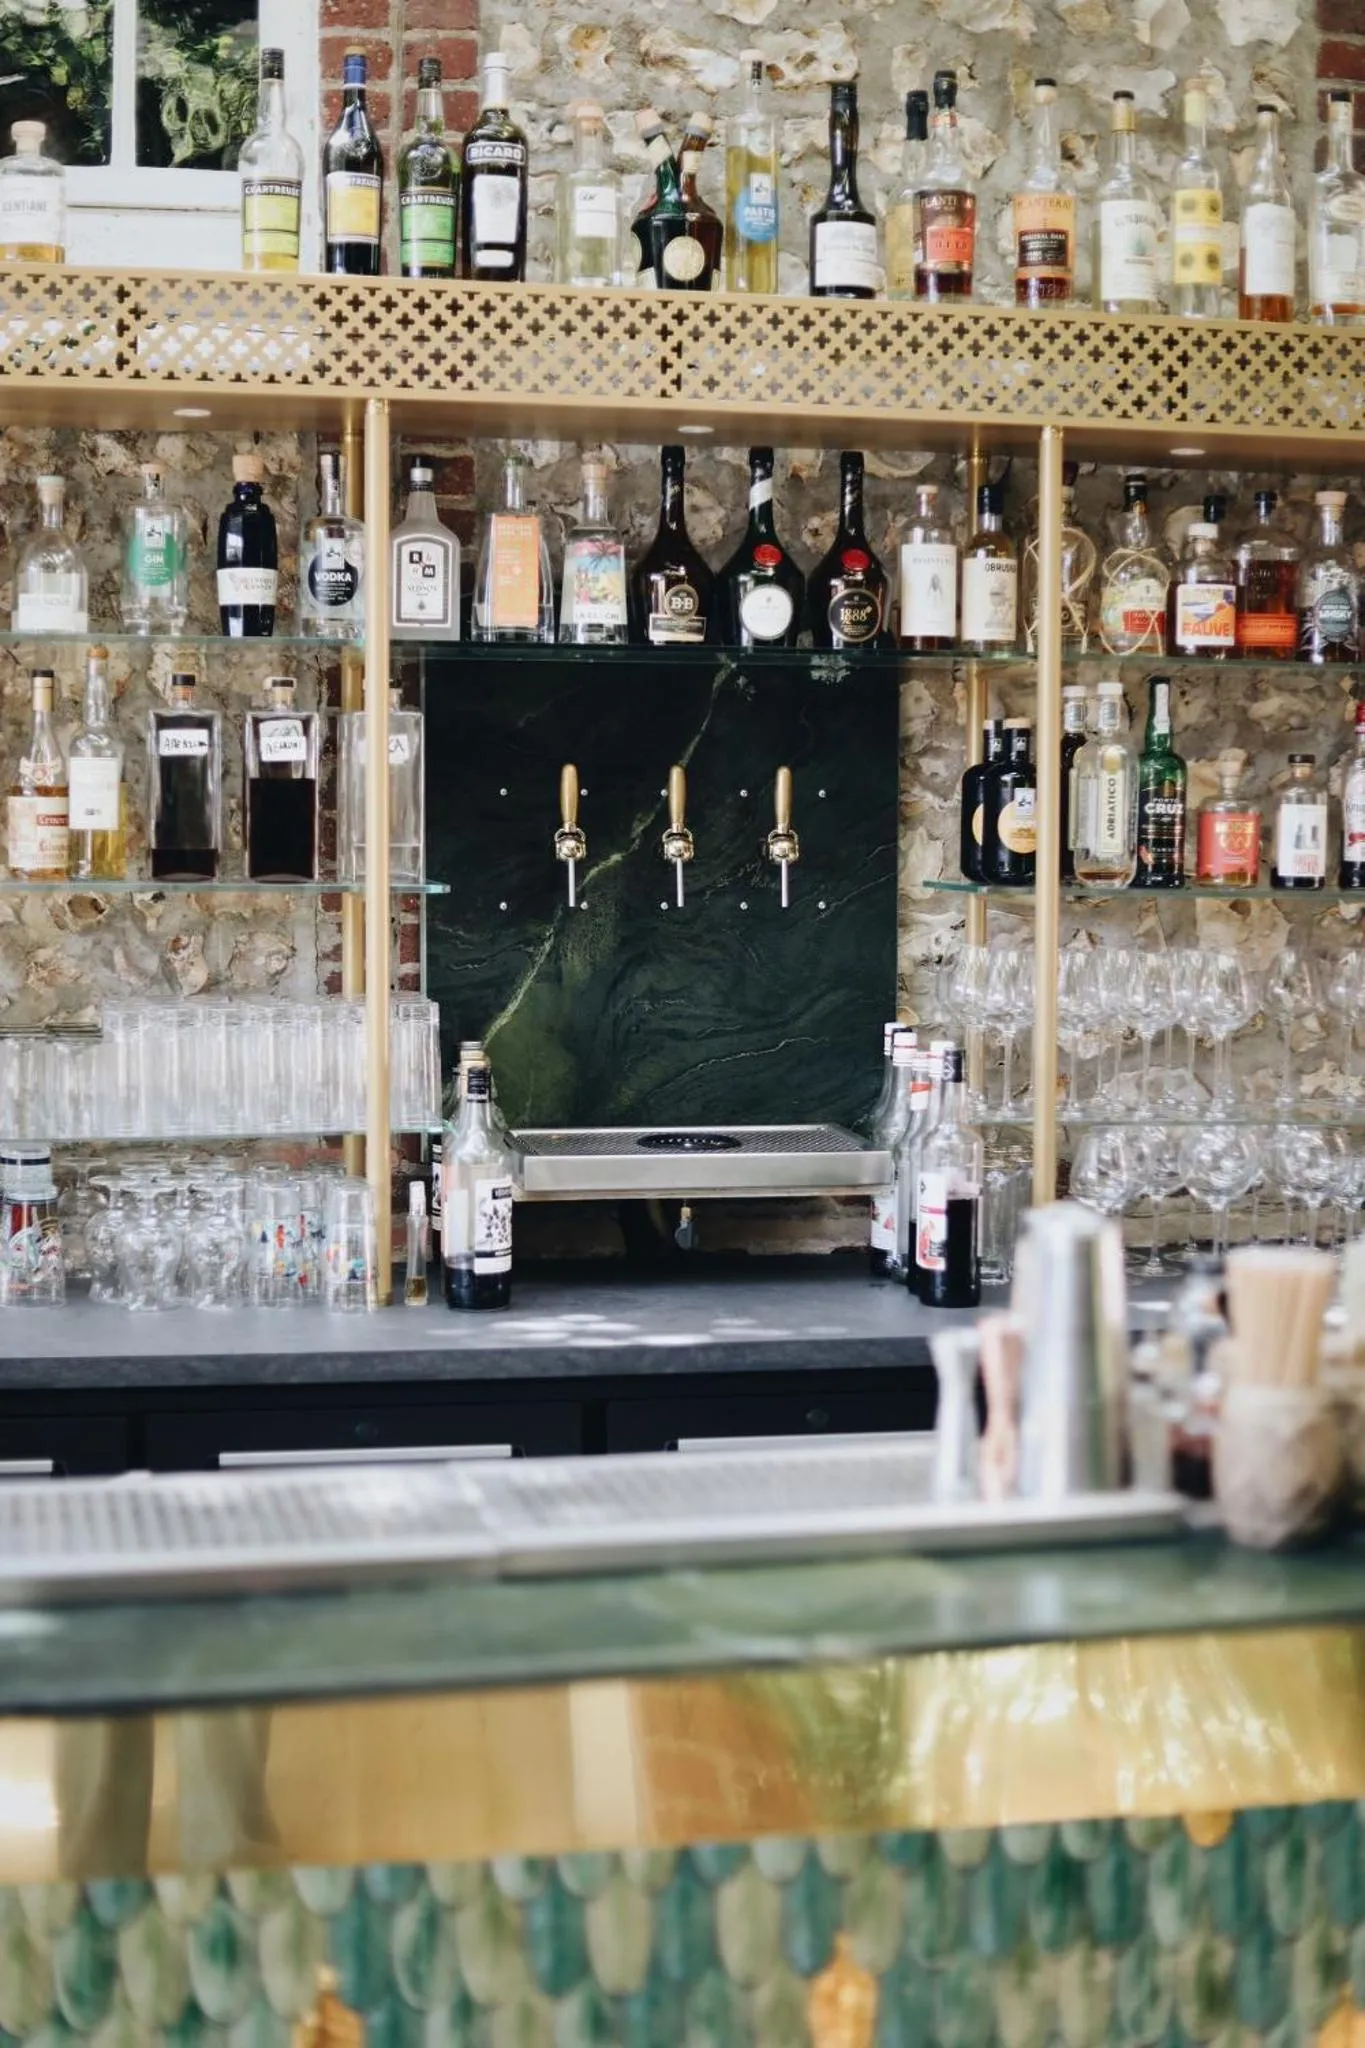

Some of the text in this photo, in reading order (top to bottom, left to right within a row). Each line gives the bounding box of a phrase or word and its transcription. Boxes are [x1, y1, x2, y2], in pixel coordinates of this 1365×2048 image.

[469, 146, 523, 160] RICARD
[314, 571, 352, 582] VODKA
[1182, 622, 1231, 637] FAUVE
[1107, 778, 1117, 839] ADRIATICO
[1144, 803, 1184, 815] CRUZ
